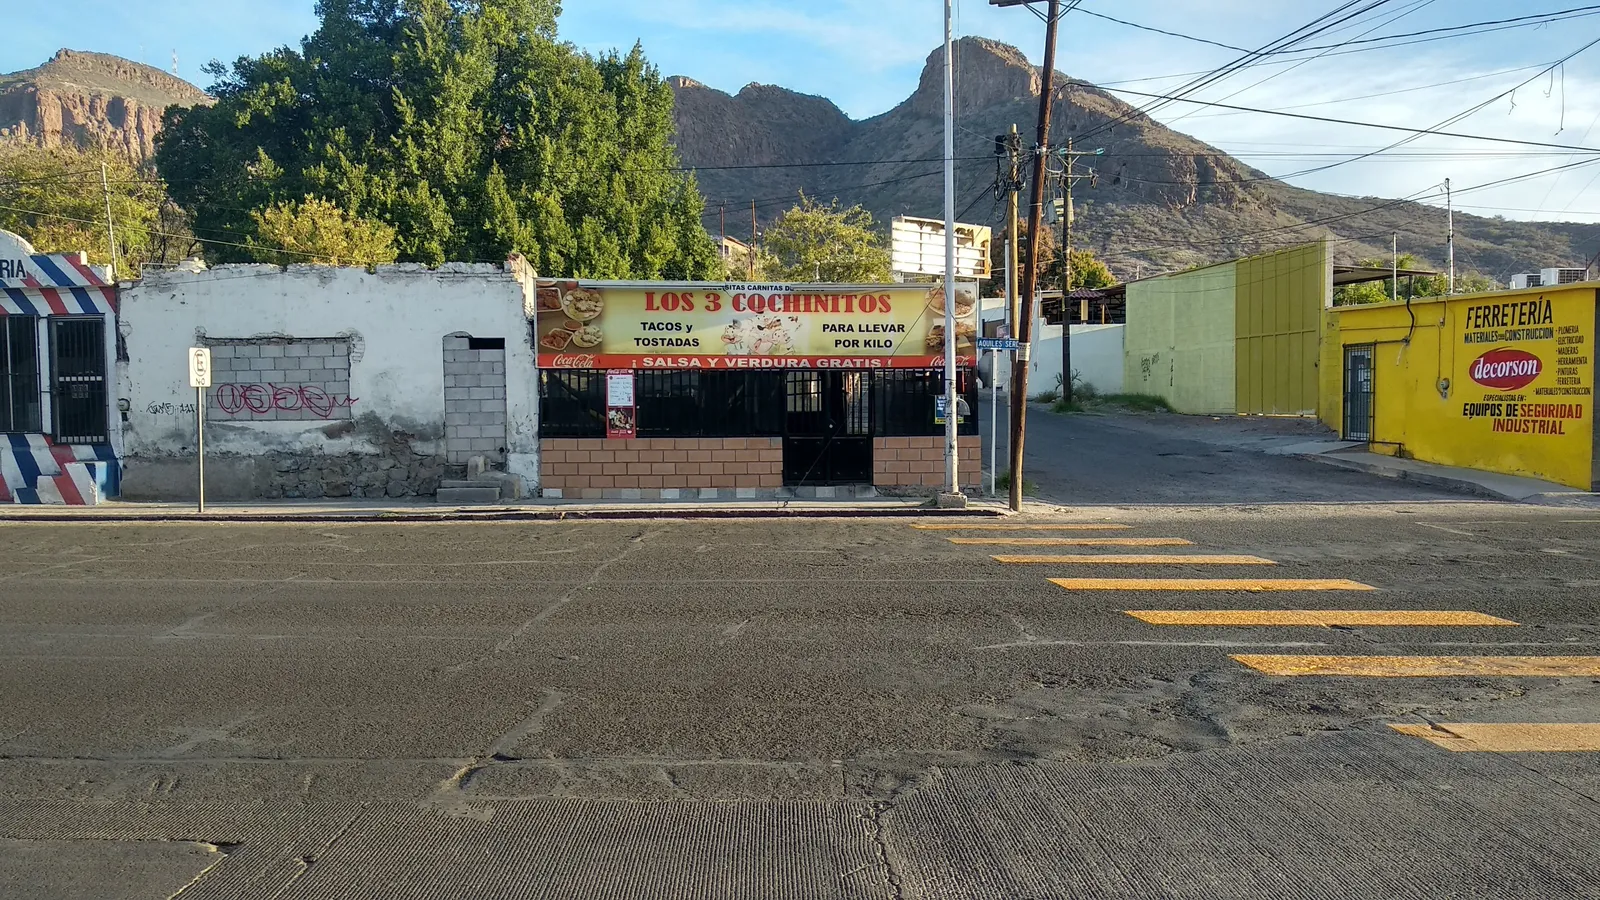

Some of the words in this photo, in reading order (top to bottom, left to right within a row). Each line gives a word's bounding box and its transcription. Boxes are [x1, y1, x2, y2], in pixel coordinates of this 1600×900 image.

[645, 291, 695, 312] LOS
[704, 292, 722, 312] 3
[732, 293, 892, 313] COCHINITOS
[1465, 295, 1553, 329] FERRETERÍA
[641, 322, 683, 331] TACOS
[822, 323, 855, 333] PARA
[858, 323, 905, 333] LLEVAR
[1464, 330, 1498, 344] MATERIALES
[1504, 327, 1554, 341] CONSTRUCCION
[634, 337, 700, 347] TOSTADAS
[834, 339, 860, 348] POR
[863, 339, 893, 349] KILO
[978, 340, 1003, 348] AQUILES
[1558, 346, 1579, 355] MADERAS
[643, 357, 702, 367] SALSA
[707, 357, 720, 367] Y
[724, 357, 808, 368] VERDURA
[816, 358, 882, 368] GRATIS
[1474, 357, 1539, 379] decorson
[195, 378, 205, 386] NO
[1463, 403, 1502, 419] EQUIPOS
[1505, 404, 1518, 417] DE
[1520, 404, 1582, 418] SEGURIDAD
[1492, 418, 1566, 435] INDUSTRIAL
